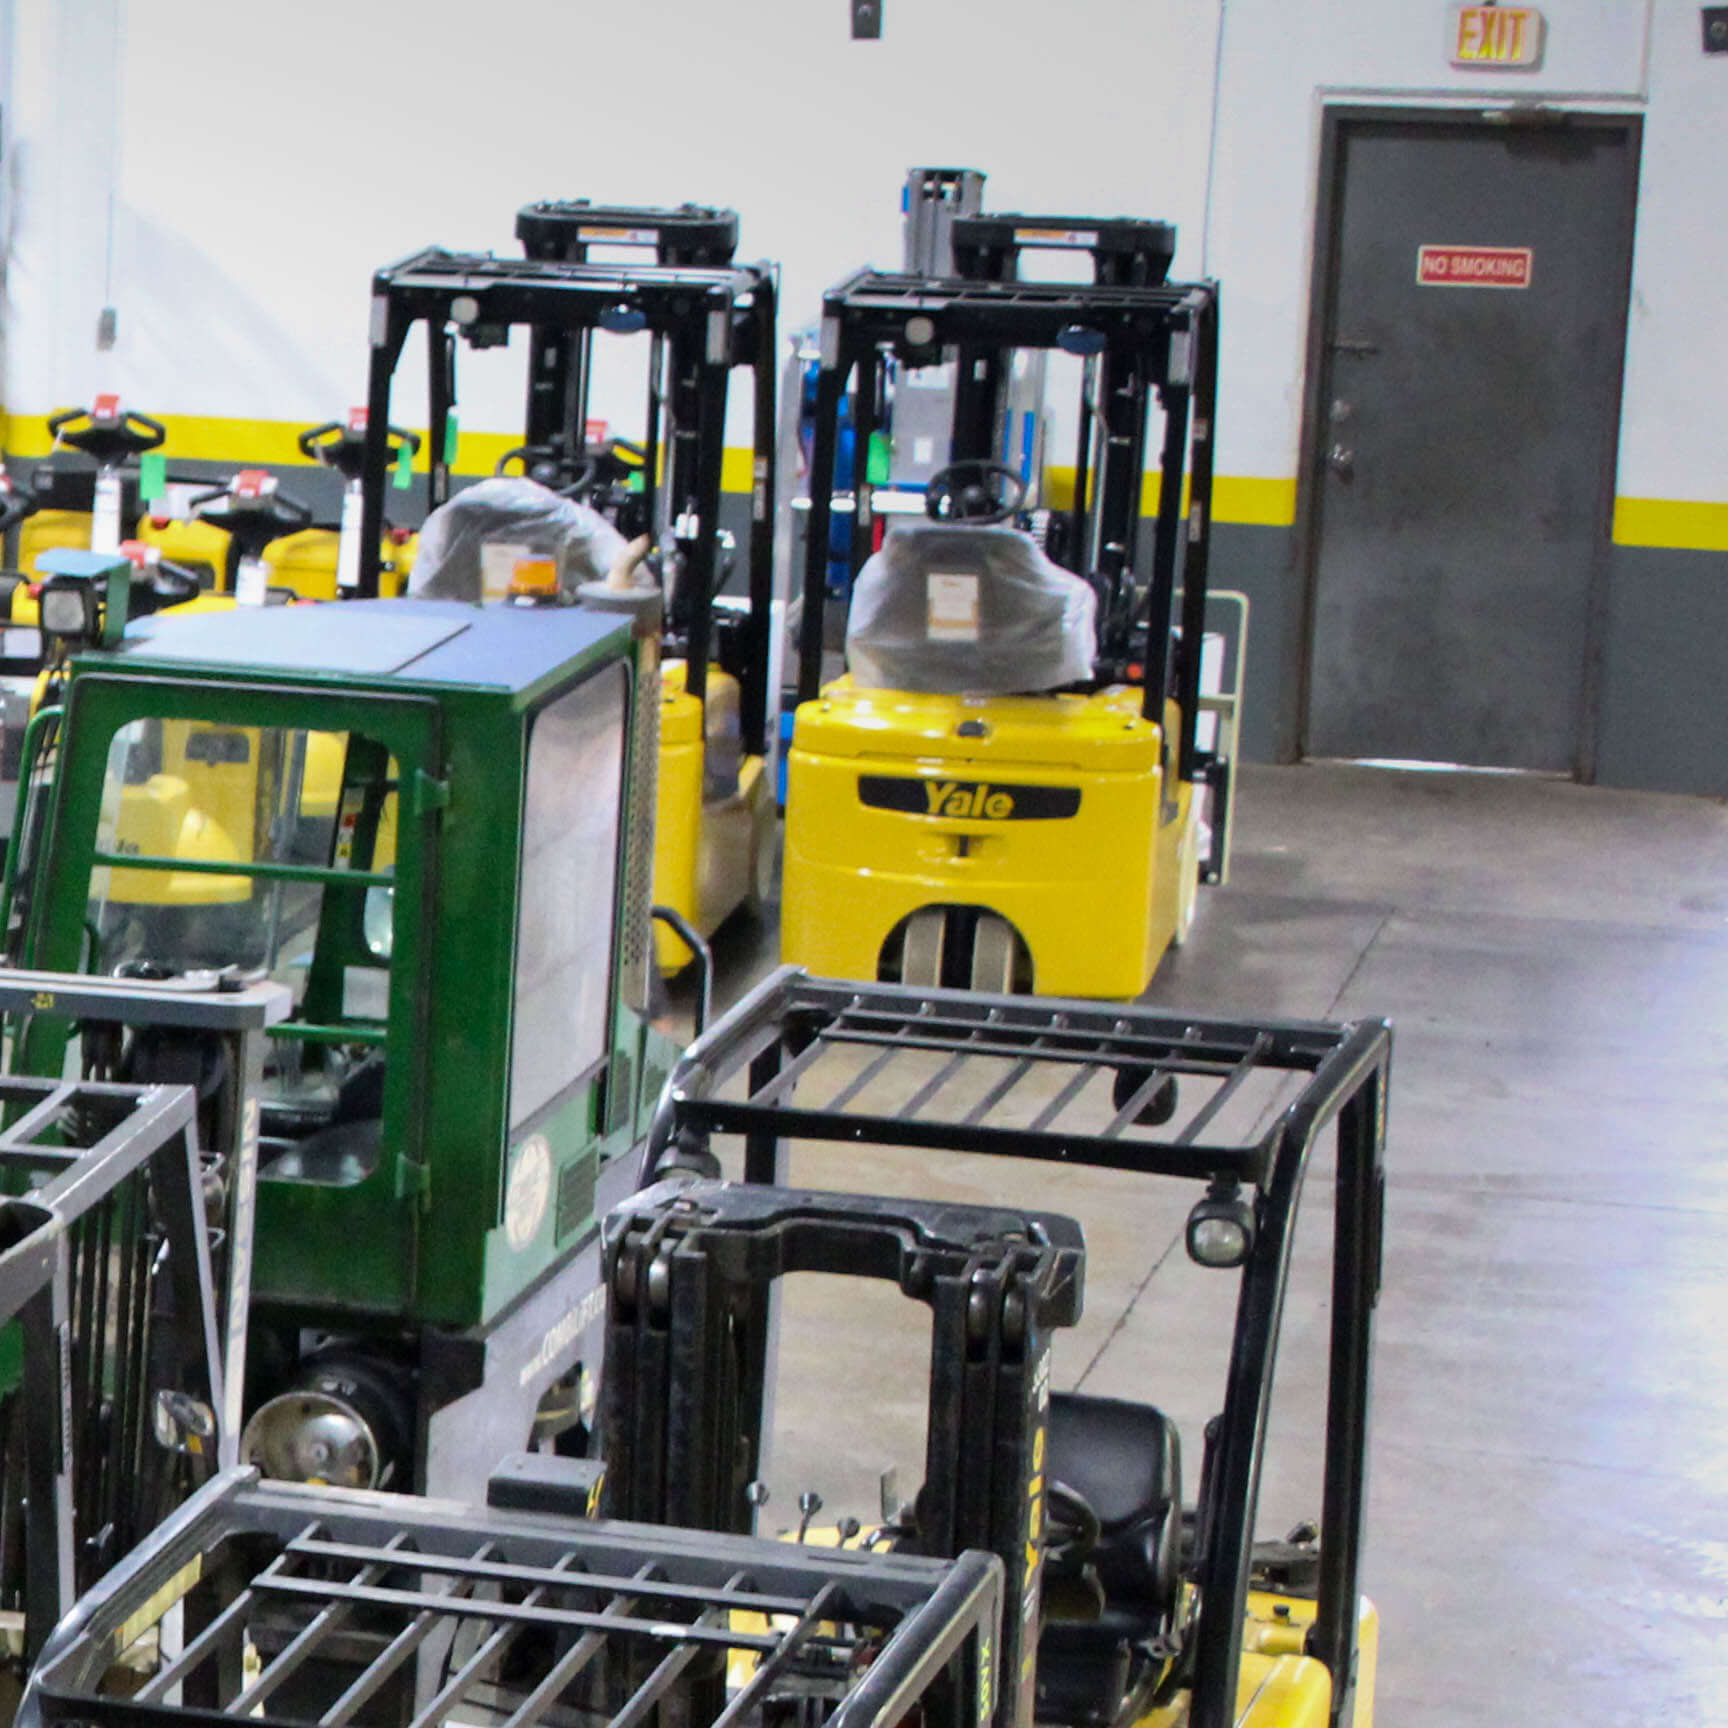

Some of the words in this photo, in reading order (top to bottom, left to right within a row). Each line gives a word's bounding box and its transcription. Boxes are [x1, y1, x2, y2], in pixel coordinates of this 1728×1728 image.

[1458, 10, 1528, 60] EXIT
[1423, 256, 1446, 275] NO
[1451, 257, 1526, 278] SMOKING
[925, 780, 1015, 819] Yale
